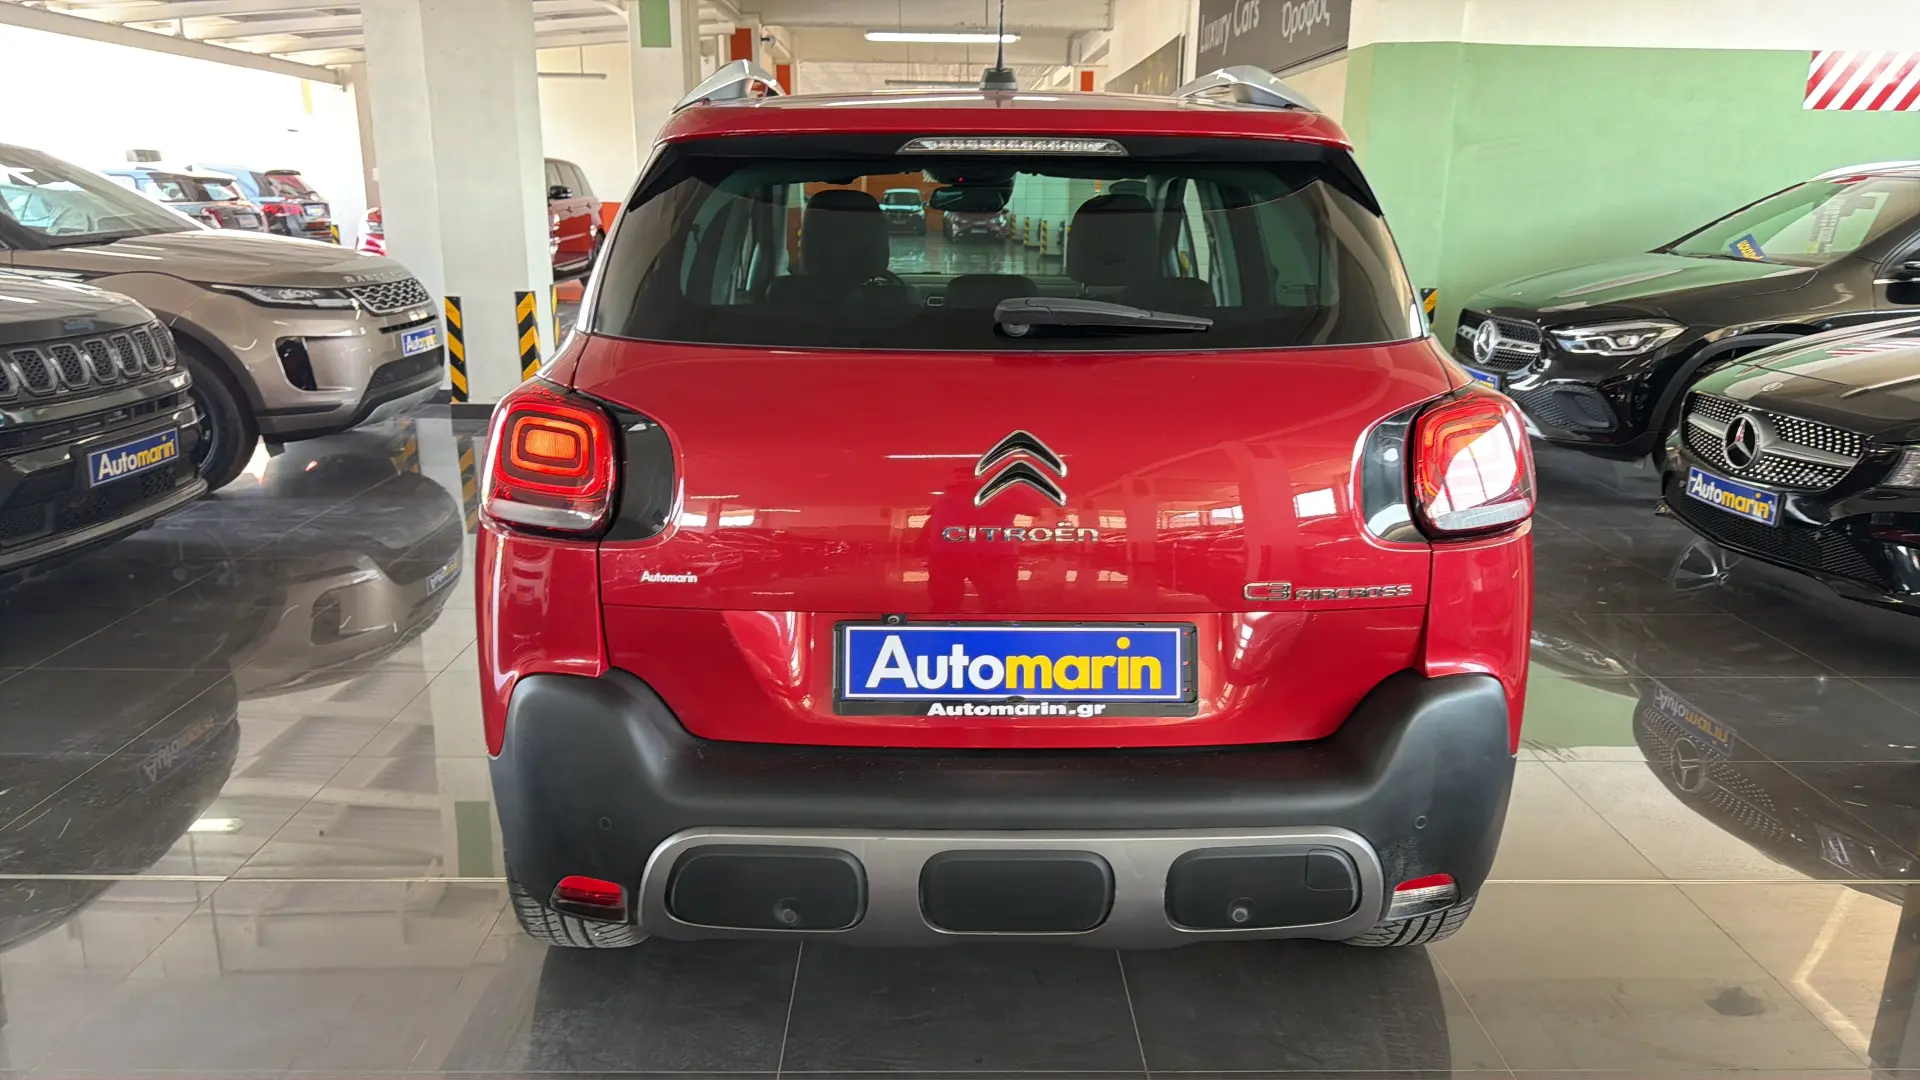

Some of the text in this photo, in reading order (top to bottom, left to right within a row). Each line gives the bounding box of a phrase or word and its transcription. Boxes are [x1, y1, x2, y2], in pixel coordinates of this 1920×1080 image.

[1200, 0, 1260, 56] Luxury Cars
[98, 435, 175, 480] Automarin
[1691, 473, 1770, 519] Automarin
[640, 570, 698, 583] Automarin
[1243, 582, 1413, 600] C3 AIRCROSS
[865, 635, 1162, 690] Automarin
[927, 701, 1106, 717] Automarin.gr
